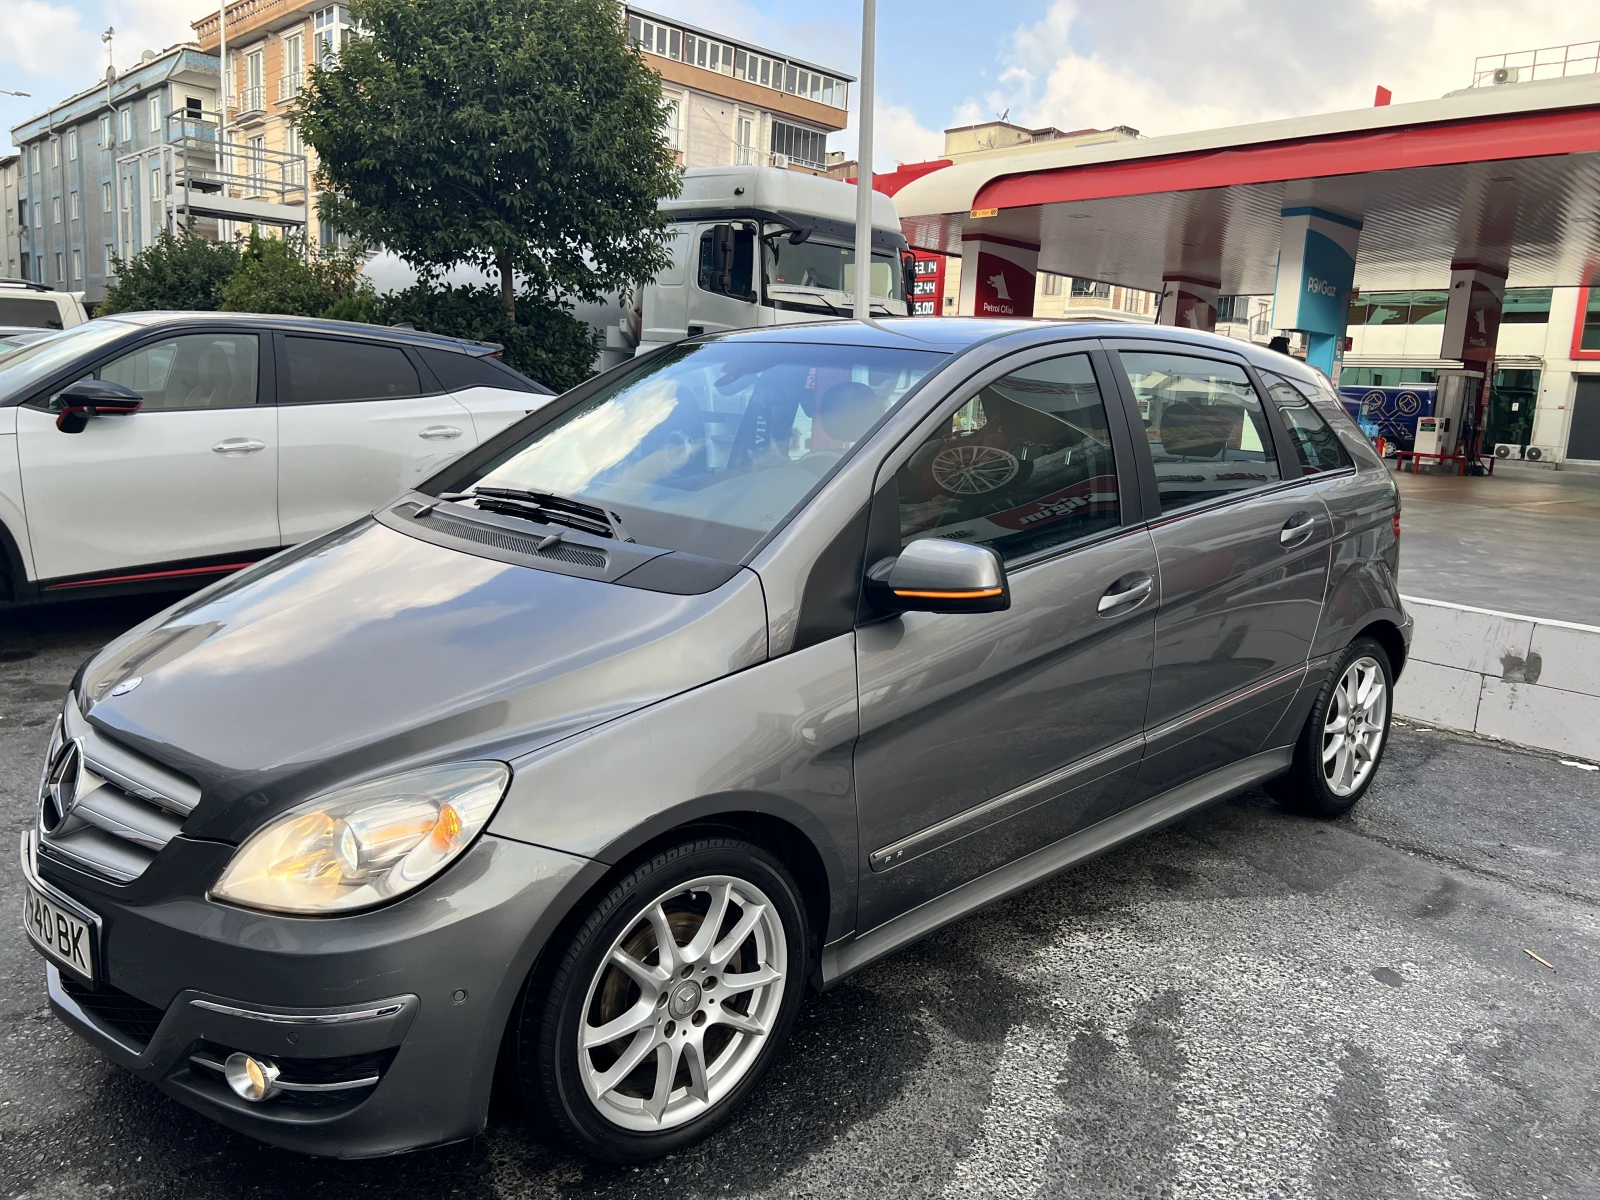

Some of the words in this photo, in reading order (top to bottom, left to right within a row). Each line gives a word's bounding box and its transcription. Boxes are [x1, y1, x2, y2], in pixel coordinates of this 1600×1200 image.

[913, 302, 935, 315] 5.00
[983, 302, 1000, 313] Petrol
[1000, 304, 1014, 315] Ofisi
[755, 415, 767, 445] VIP
[56, 912, 88, 970] BK
